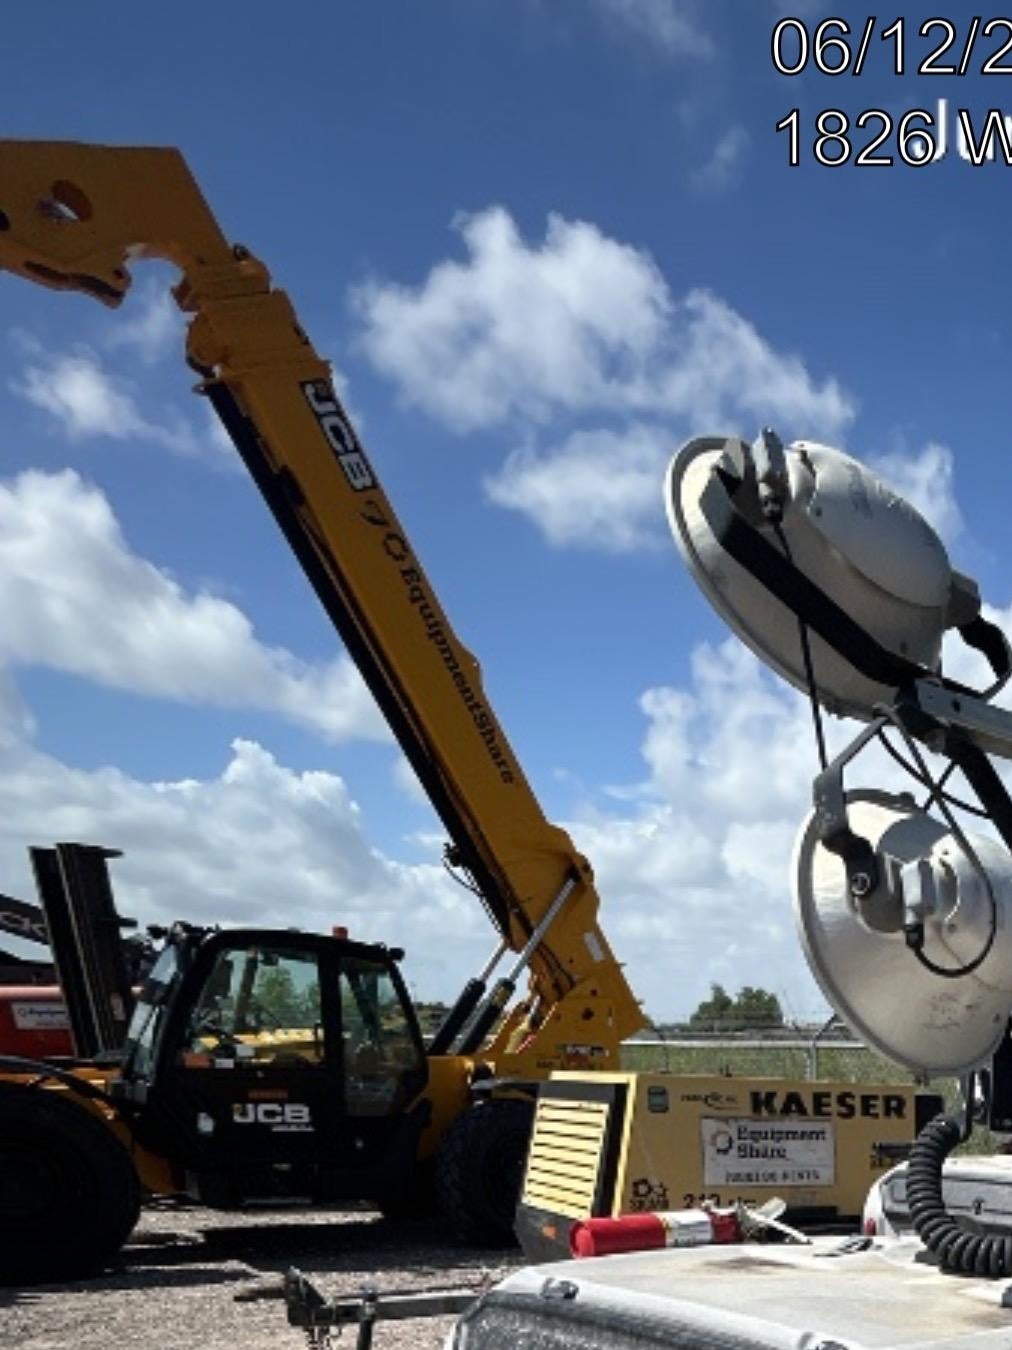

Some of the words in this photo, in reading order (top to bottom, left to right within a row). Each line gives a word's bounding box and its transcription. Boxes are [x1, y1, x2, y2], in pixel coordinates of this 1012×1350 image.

[303, 376, 379, 492] JCB
[232, 1103, 311, 1123] JCB
[749, 1090, 908, 1120] KAESER
